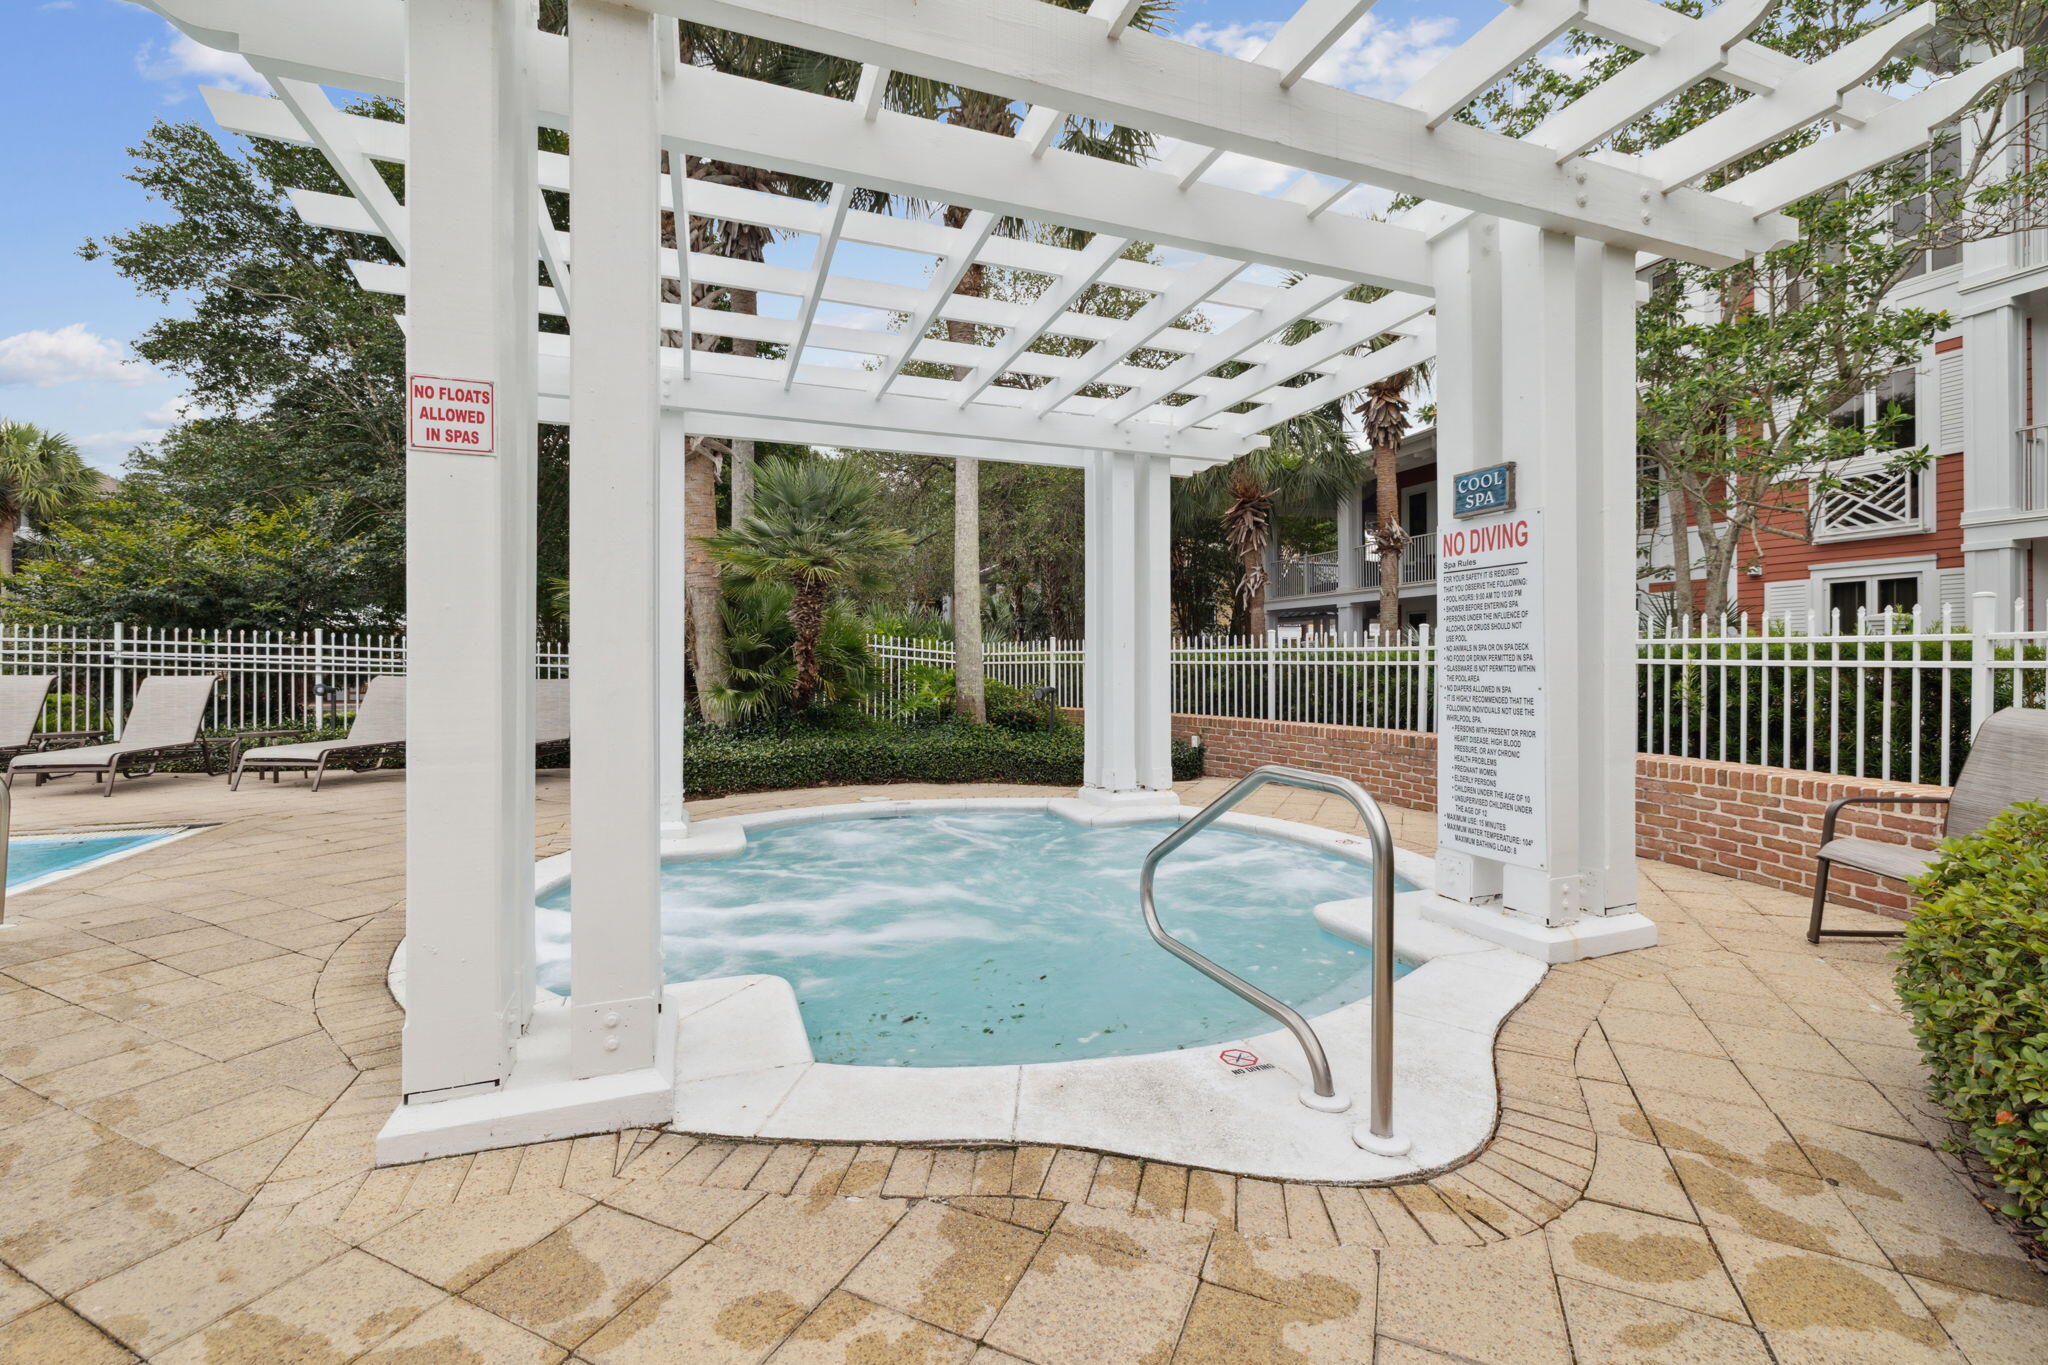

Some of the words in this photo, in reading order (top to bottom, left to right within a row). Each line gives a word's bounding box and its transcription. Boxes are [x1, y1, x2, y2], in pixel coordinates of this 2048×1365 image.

[415, 385, 434, 399] NO
[439, 387, 490, 404] FLOATS
[420, 406, 485, 424] ALLOWED
[426, 428, 440, 441] IN
[445, 429, 479, 444] SPAS
[1459, 472, 1502, 493] COOL
[1465, 491, 1495, 508] SPA
[1444, 531, 1464, 557] NO
[1470, 521, 1528, 554] DIVING
[1494, 568, 1519, 577] REQUIRED
[1465, 582, 1485, 591] OBSERVE
[1493, 611, 1520, 619] INFLUENCE
[1472, 706, 1500, 714] INDIVIDUALS
[1455, 725, 1475, 733] PERSONS
[1488, 728, 1510, 736] PRESENT
[1520, 730, 1536, 738] PRIOR
[1504, 739, 1521, 747] BLOOD
[1498, 750, 1520, 758] CHRONIC
[1454, 755, 1471, 763] HEALTH
[1472, 757, 1497, 766] PROBLEMS
[1455, 765, 1478, 774] PREGNANT
[1479, 768, 1497, 776] WOMEN
[1455, 775, 1474, 784] ELDERLY
[1475, 778, 1496, 787] PERSONS
[1455, 785, 1476, 794] CHILDREN
[1477, 788, 1493, 797] UNDER
[1455, 795, 1488, 807] UNSUPERVISED
[1489, 800, 1513, 811] CHILDREN
[1514, 804, 1532, 814] UNDER
[1465, 806, 1474, 815] AGE
[1447, 813, 1466, 822] MAXIMUM
[1485, 820, 1506, 831] MINUTES
[1447, 823, 1466, 833] MAXIMUM
[1468, 827, 1483, 836] WATER
[1484, 830, 1521, 845] TEMPERATURE:
[1455, 835, 1475, 845] MAXIMUM
[1476, 839, 1496, 850] BATHING
[1497, 844, 1512, 853] LOAD:
